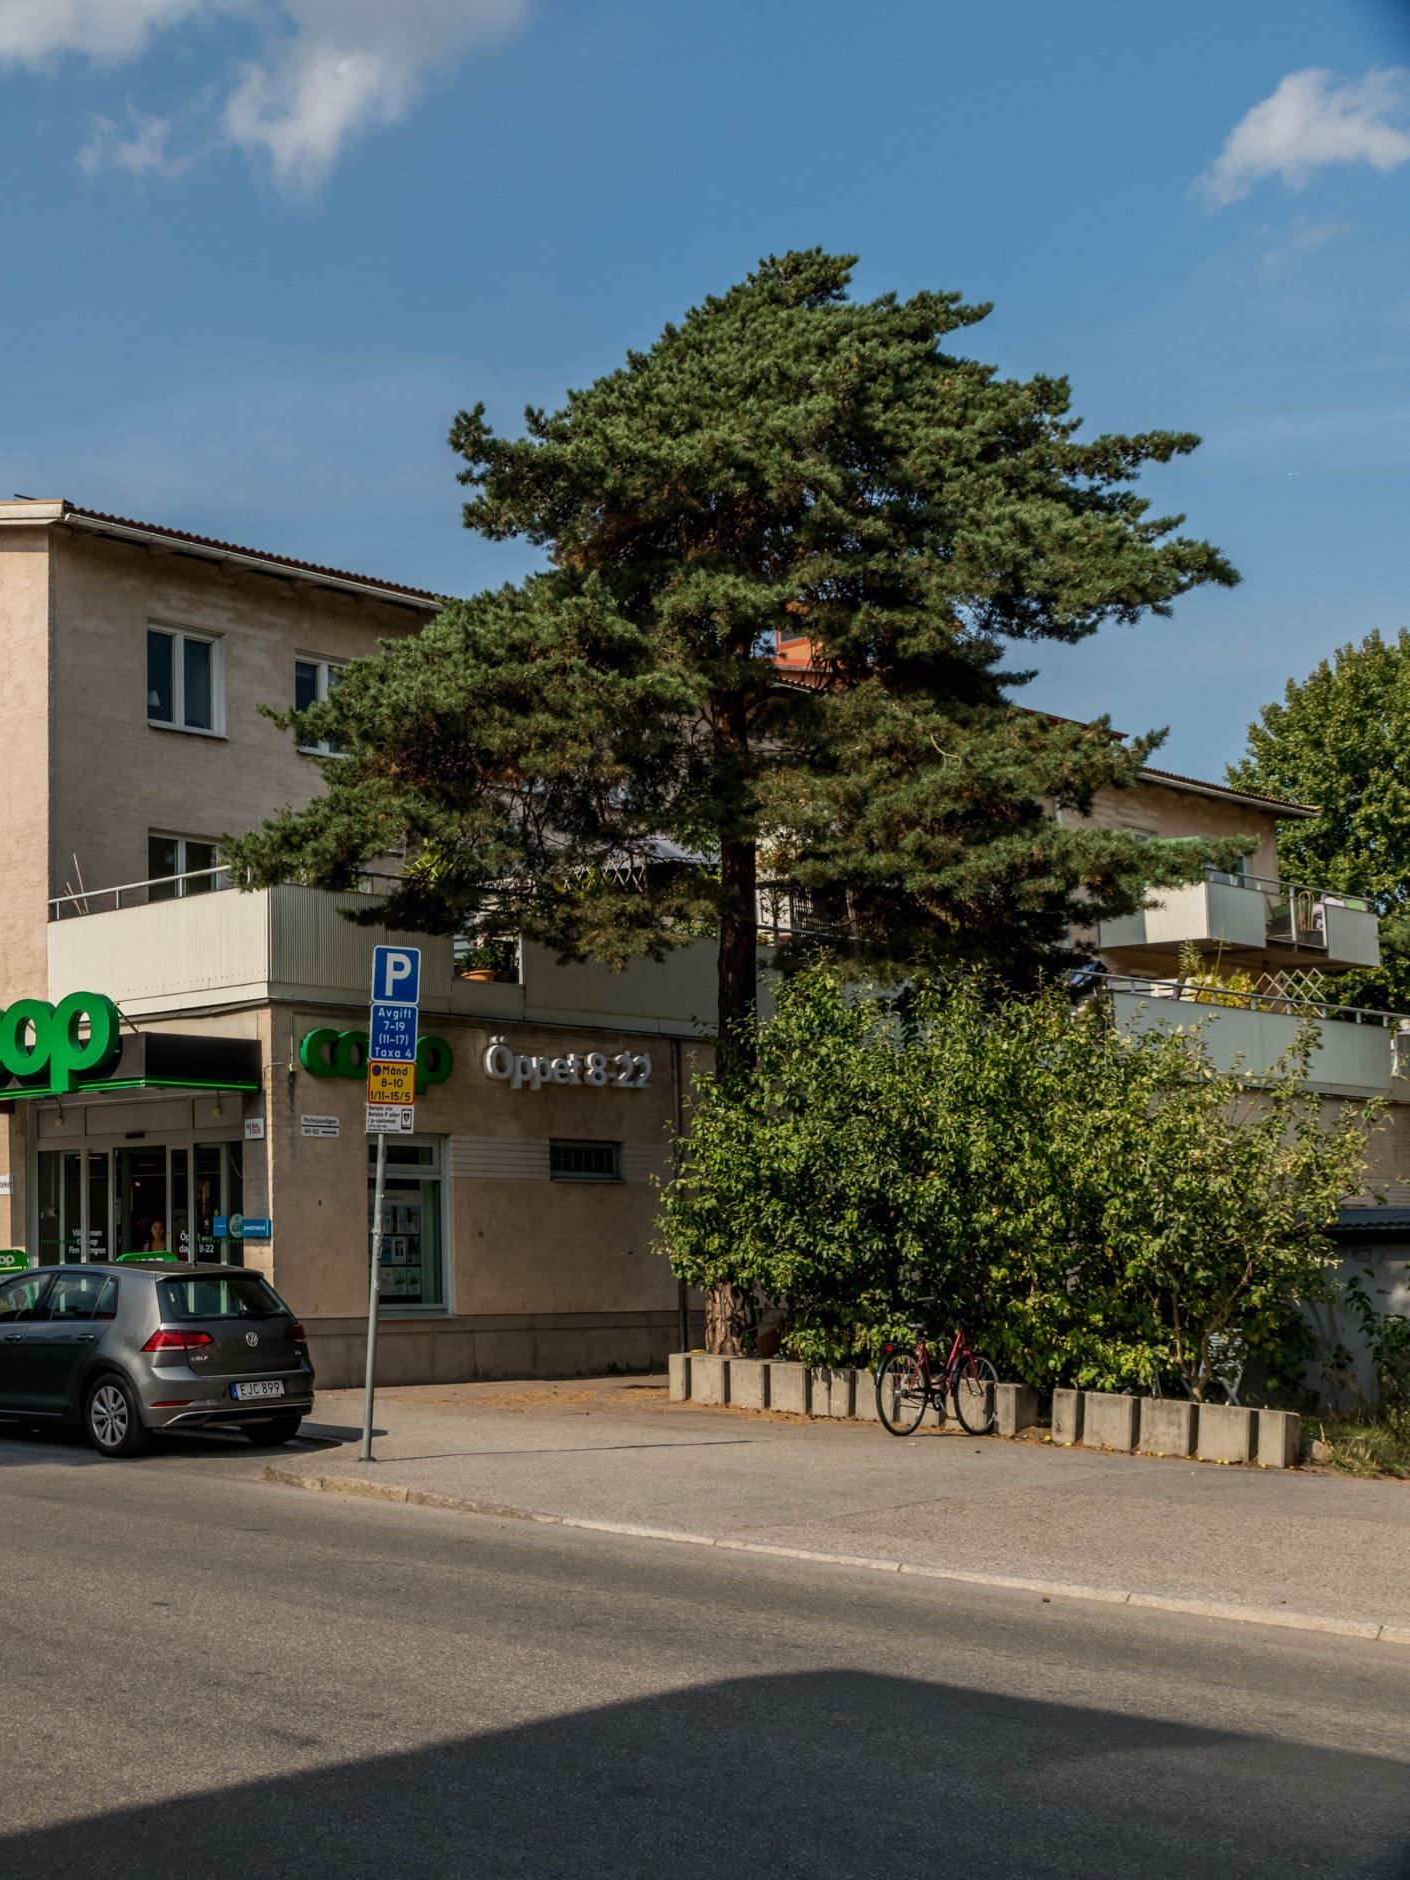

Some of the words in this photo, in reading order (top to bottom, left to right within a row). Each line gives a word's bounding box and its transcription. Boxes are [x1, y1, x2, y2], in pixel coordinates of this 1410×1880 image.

[385, 952, 412, 997] P
[378, 1007, 412, 1020] Avgift
[383, 1020, 406, 1032] 7-19
[378, 1033, 409, 1046] (11-17)
[375, 1047, 401, 1058] Taxa
[405, 1048, 412, 1058] 4
[299, 1028, 454, 1096] cop
[483, 1036, 581, 1090] Öppet
[584, 1050, 653, 1088] 8-22
[382, 1065, 408, 1076] Månd
[381, 1078, 404, 1088] 8-10
[370, 1091, 411, 1101] 1/11-15/5
[198, 1245, 215, 1253] 8-22
[240, 1384, 260, 1395] EJC
[261, 1382, 280, 1394] 899
